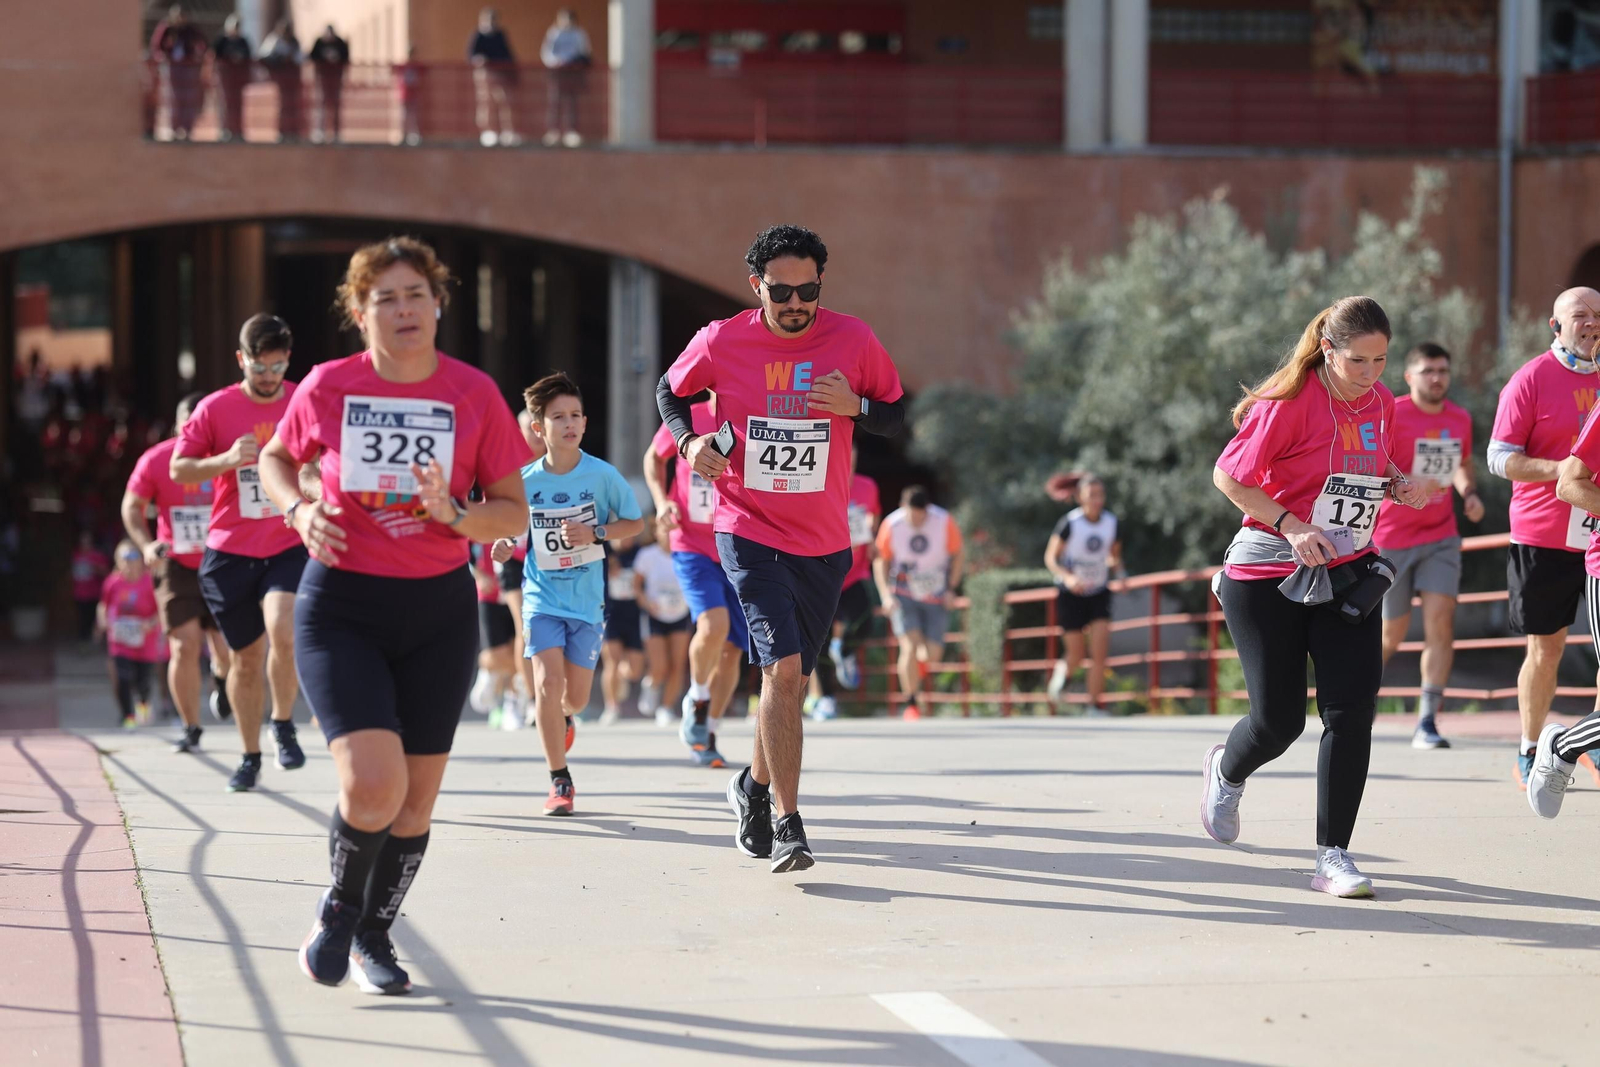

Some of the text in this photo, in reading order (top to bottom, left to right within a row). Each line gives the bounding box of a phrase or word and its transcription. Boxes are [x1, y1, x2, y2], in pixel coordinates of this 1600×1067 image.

[765, 361, 812, 390] WE
[769, 396, 807, 415] RUN
[1573, 388, 1600, 411] W
[350, 412, 397, 427] UMA
[751, 429, 788, 440] UMA
[1338, 422, 1377, 450] WE
[361, 431, 436, 467] 328
[758, 445, 817, 471] 424
[1423, 456, 1453, 474] 293
[773, 481, 788, 489] WE
[1328, 484, 1360, 497] UMA
[534, 519, 562, 528] UMA
[1328, 498, 1376, 530] 123
